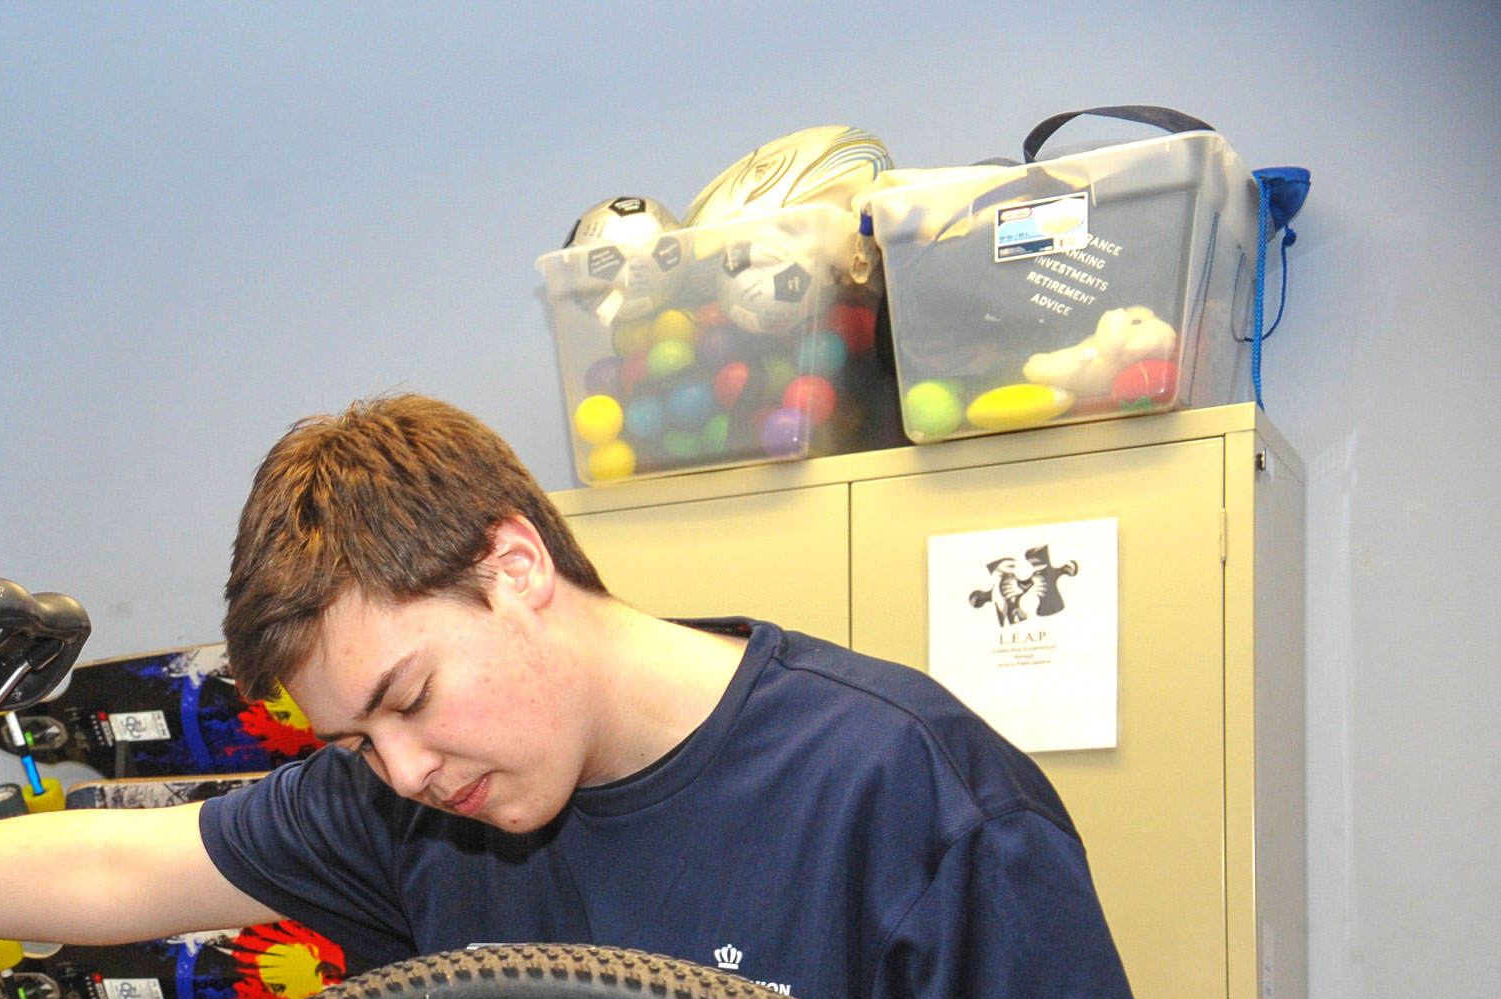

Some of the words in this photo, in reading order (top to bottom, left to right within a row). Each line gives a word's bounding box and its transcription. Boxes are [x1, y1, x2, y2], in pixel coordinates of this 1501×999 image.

[1087, 234, 1123, 257] RANCE
[1034, 256, 1109, 291] INVESTMENTS
[1027, 271, 1097, 305] RETIREMENT
[1030, 293, 1073, 316] ADVICE
